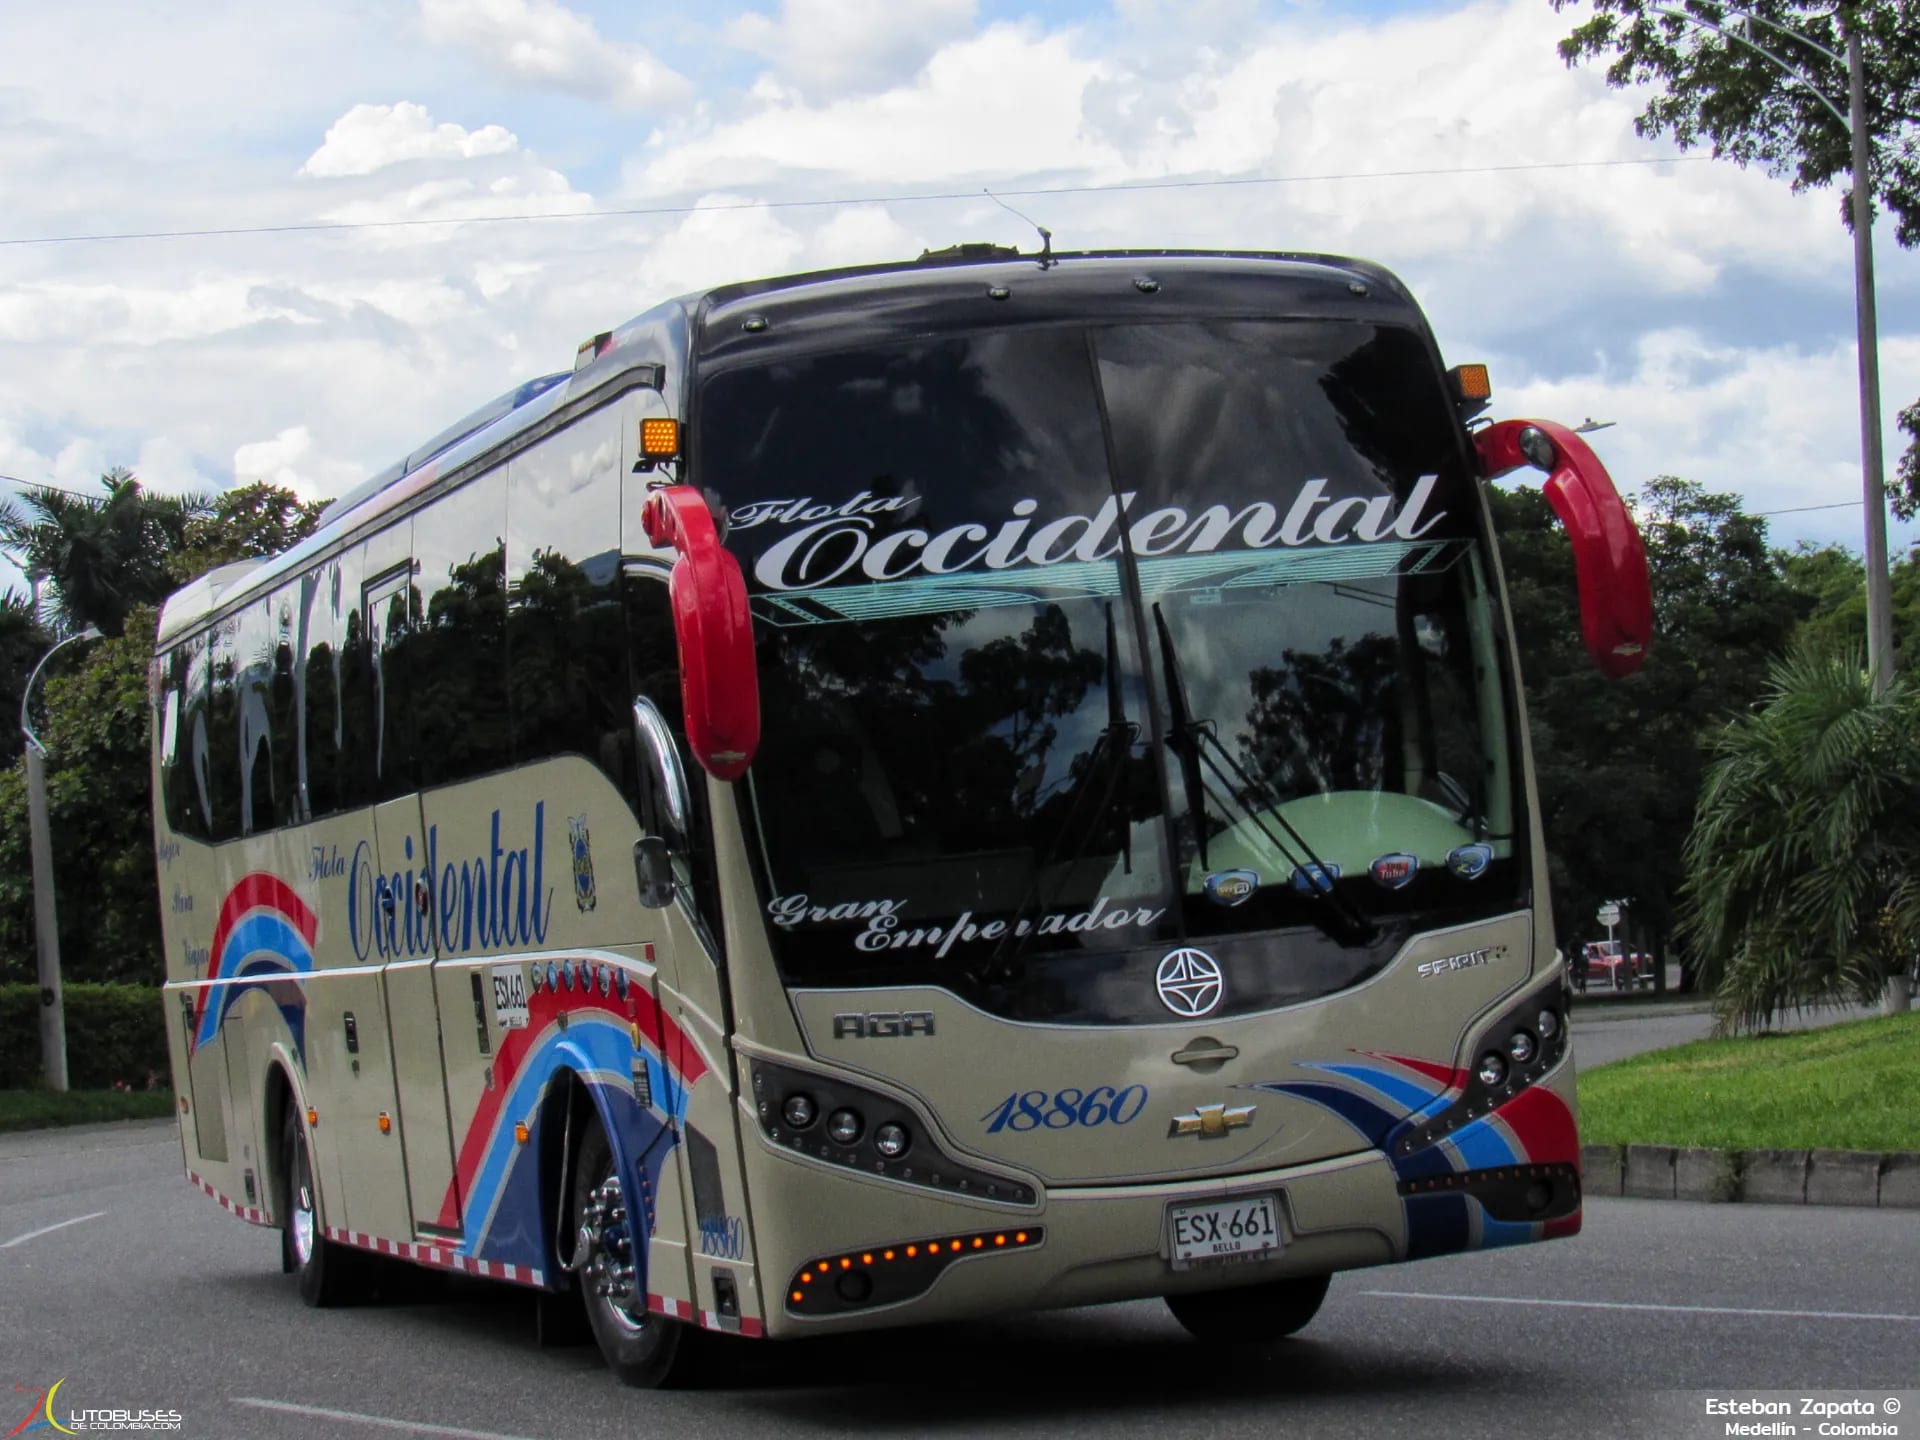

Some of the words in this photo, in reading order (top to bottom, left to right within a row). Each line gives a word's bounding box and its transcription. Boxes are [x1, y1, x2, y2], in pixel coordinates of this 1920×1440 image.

[728, 491, 922, 530] Flota
[754, 474, 1448, 591] Occidental
[348, 800, 555, 962] Occidental
[766, 894, 908, 926] Gran
[1417, 948, 1491, 978] SPIRIT
[833, 1010, 936, 1040] AGA
[980, 1084, 1149, 1134] 18860
[1212, 1241, 1241, 1253] BELLO
